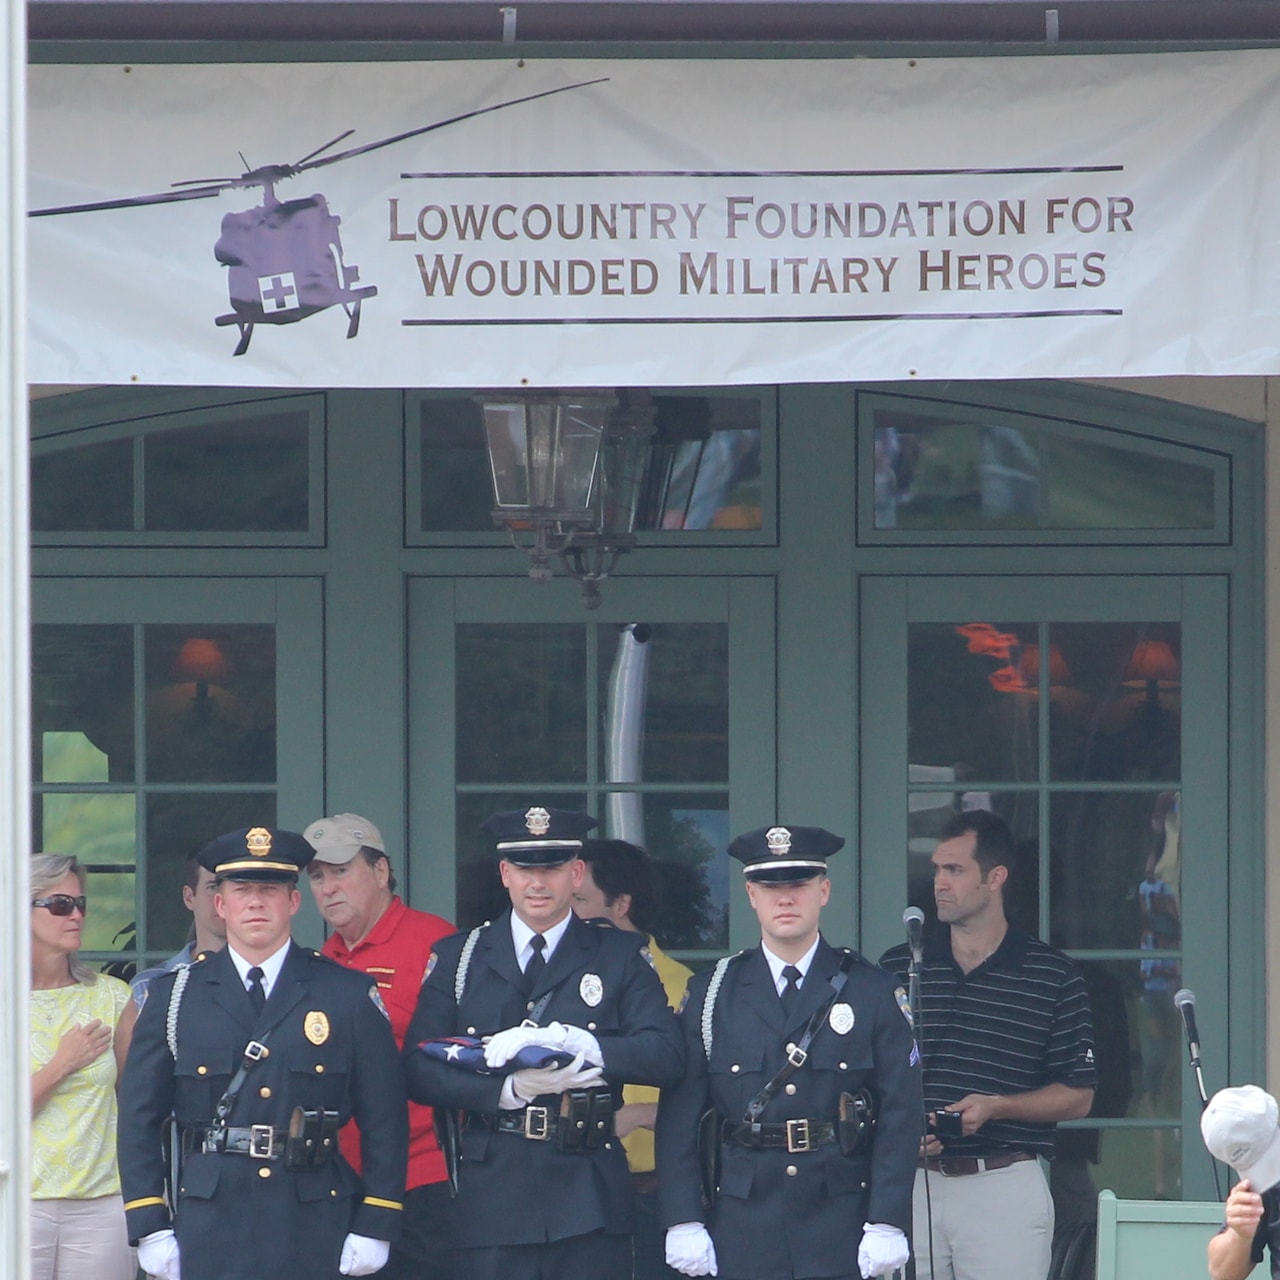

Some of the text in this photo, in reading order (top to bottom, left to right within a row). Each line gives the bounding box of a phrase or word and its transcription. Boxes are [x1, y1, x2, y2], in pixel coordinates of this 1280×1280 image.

[387, 195, 1135, 243] LOWCOUNTRY FOUNDATION FOR
[414, 249, 1107, 297] WOUNDED MILITARY HEROES
